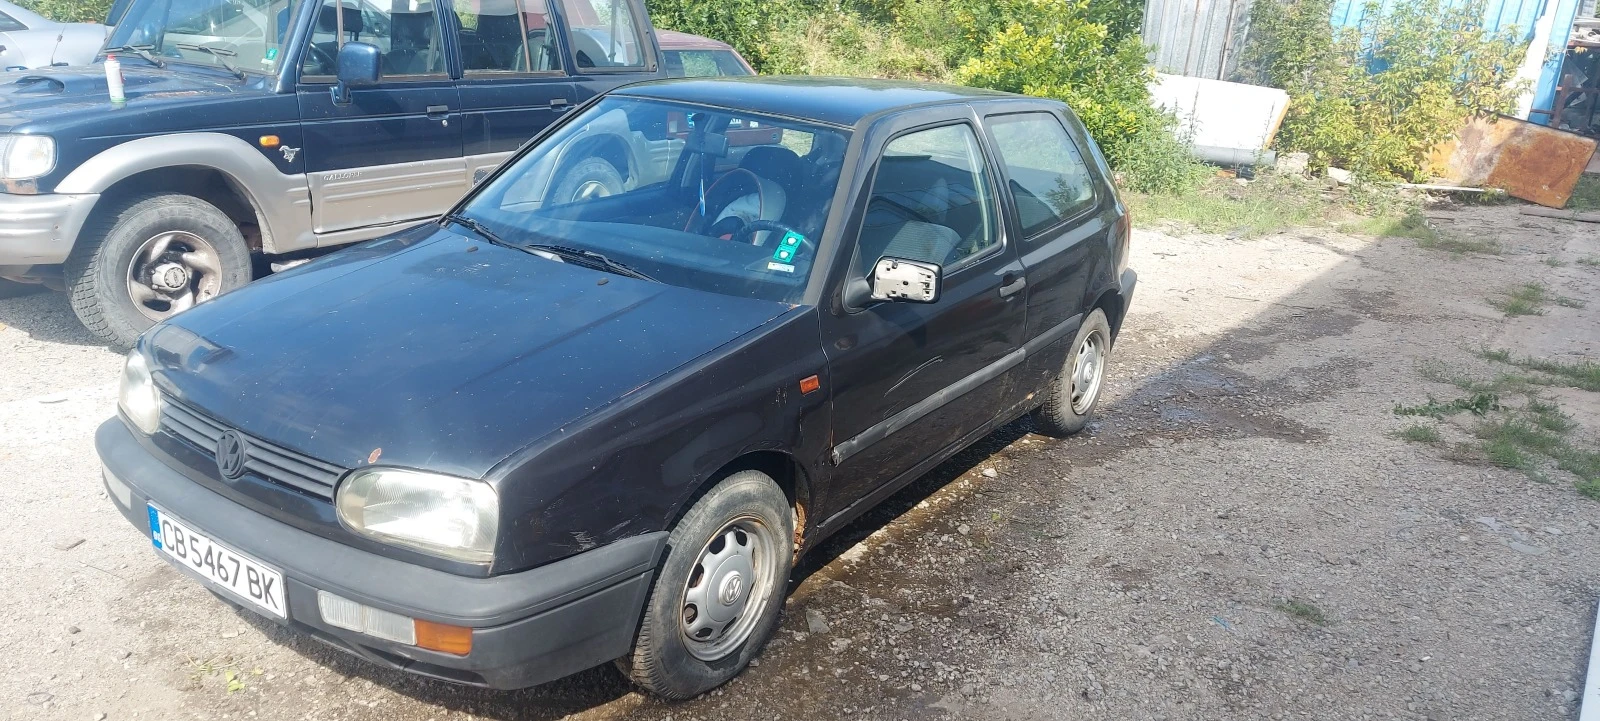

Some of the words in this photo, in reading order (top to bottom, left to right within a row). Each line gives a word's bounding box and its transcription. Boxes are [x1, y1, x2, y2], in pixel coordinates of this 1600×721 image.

[162, 519, 187, 559] CB
[189, 534, 241, 588] 5467
[246, 564, 279, 610] BK
